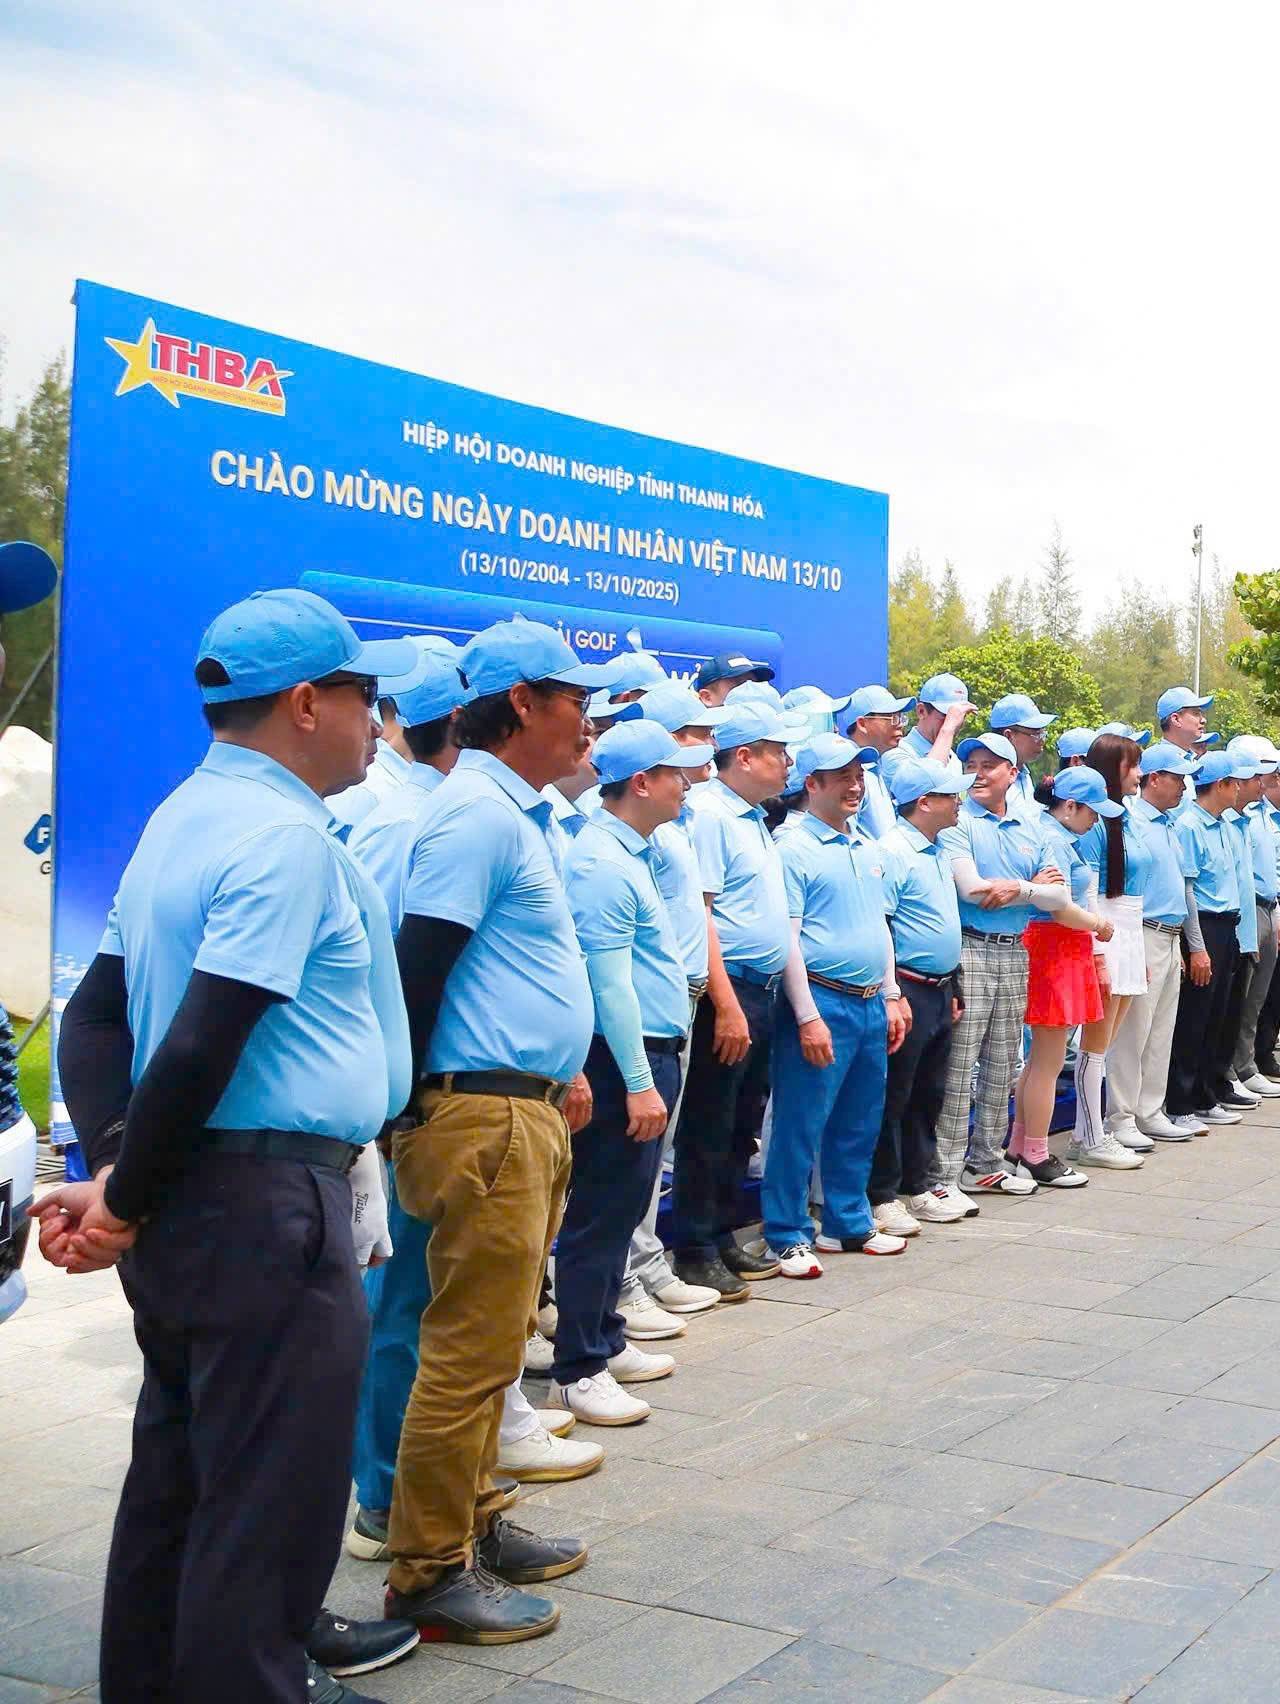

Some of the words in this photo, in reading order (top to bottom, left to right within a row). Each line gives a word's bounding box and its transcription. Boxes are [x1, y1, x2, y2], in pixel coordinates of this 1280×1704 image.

[155, 333, 284, 399] THBA
[403, 420, 449, 454] HIỆP
[455, 432, 491, 464] HỘI
[497, 443, 566, 478] DOANH
[570, 460, 634, 495] NGHIỆP
[638, 471, 674, 500] TỈNH
[677, 483, 729, 512] THANH
[732, 495, 765, 520] HÓA
[211, 450, 315, 500] CHÀO
[324, 468, 424, 520] MỪNG
[431, 492, 513, 535] NGÀY
[519, 510, 610, 554] DOANH
[617, 527, 684, 566] NHÂN
[689, 538, 736, 577] VIỆT
[741, 550, 788, 585] NAM
[791, 560, 842, 593] 13/10
[460, 549, 570, 587] (13/10/2004
[584, 571, 680, 607] 13/10/2025)
[574, 628, 618, 653] GOLF
